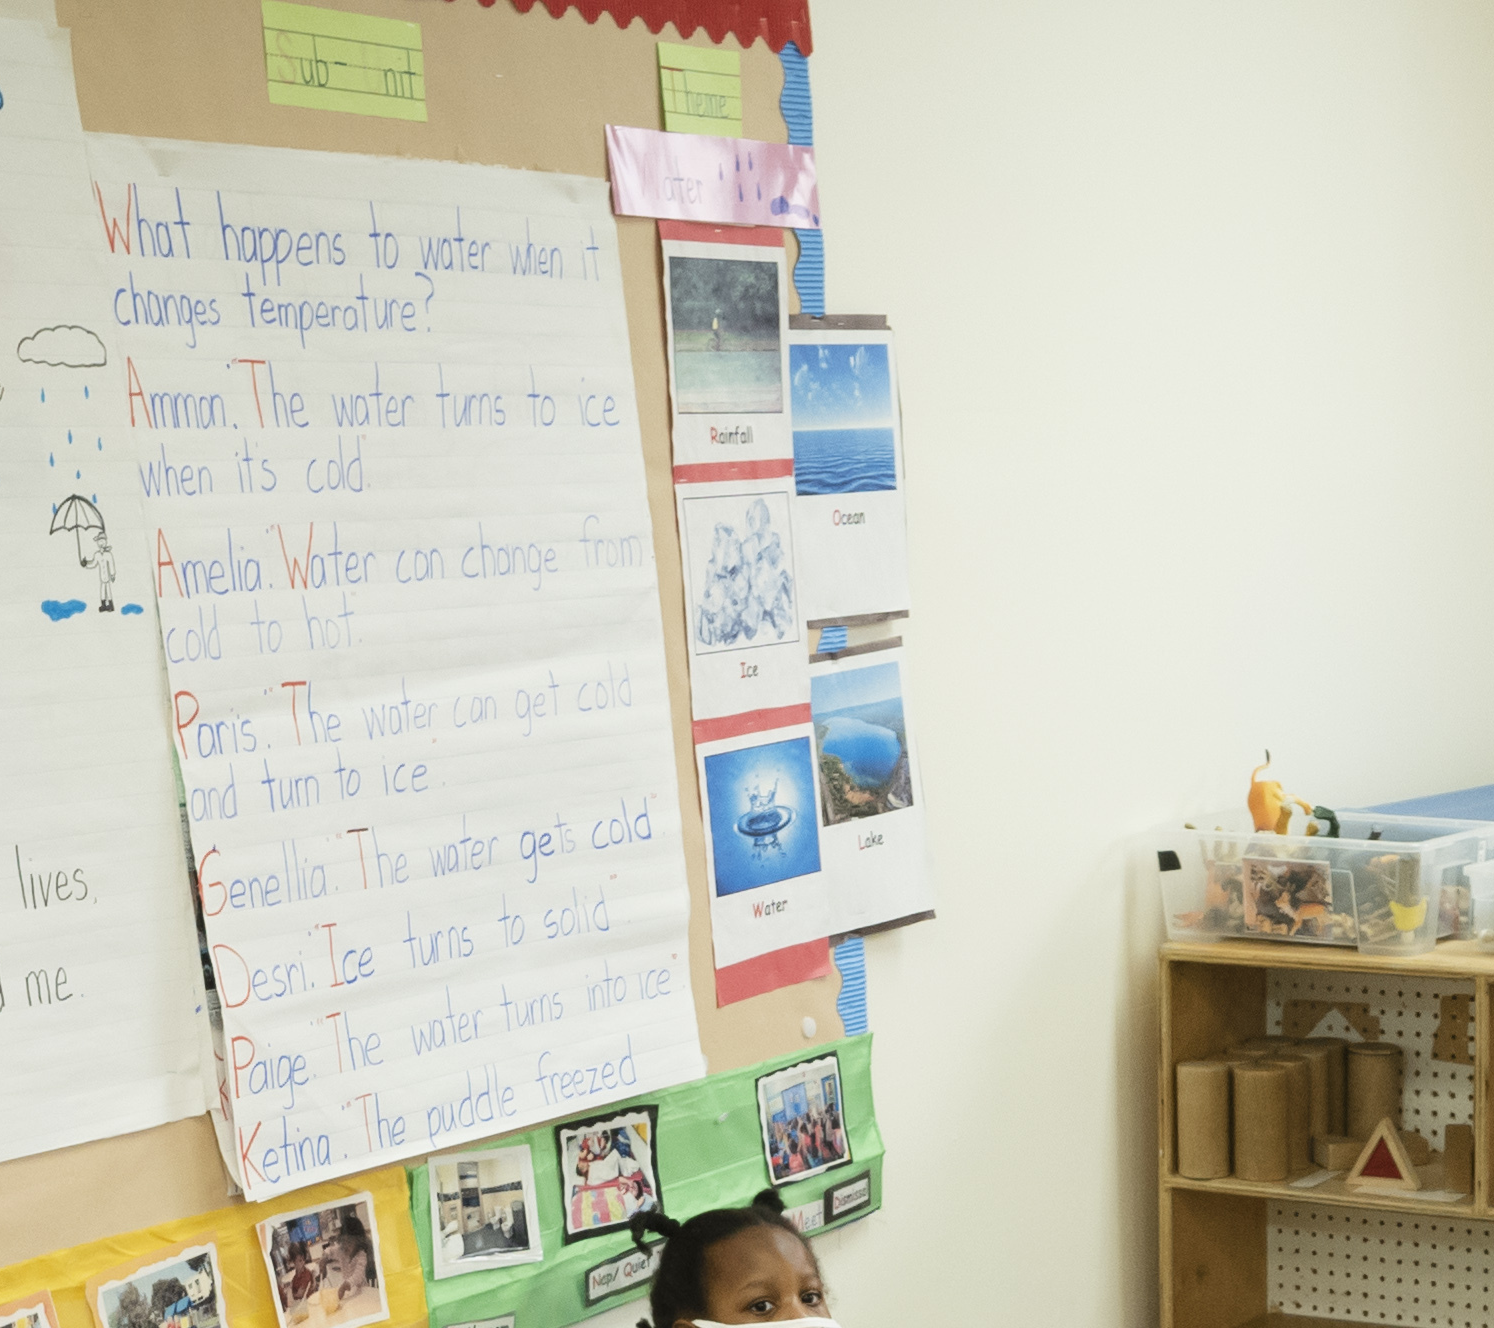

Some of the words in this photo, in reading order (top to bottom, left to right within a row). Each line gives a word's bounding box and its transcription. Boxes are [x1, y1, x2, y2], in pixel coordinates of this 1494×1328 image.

[659, 65, 729, 119] Theme
[95, 181, 190, 260] What
[217, 190, 346, 286] happens
[368, 201, 399, 269] to
[421, 206, 492, 272] water
[509, 219, 562, 279] when
[581, 226, 600, 281] it
[114, 272, 221, 348] changes
[243, 272, 435, 347] temperature?
[332, 362, 415, 427] water
[436, 364, 506, 426] turns
[527, 365, 555, 426] to
[579, 378, 621, 427] ice
[711, 426, 753, 446] Rainfall
[140, 443, 213, 498] when
[832, 509, 866, 526] Ocean
[396, 545, 444, 583] can
[461, 522, 559, 592] change
[578, 514, 643, 568] from
[166, 600, 222, 664] cold
[250, 599, 282, 654] to
[362, 677, 437, 735] water
[453, 692, 498, 729] can
[515, 670, 560, 737] get
[577, 660, 632, 713] cold
[740, 660, 759, 679] Ice
[191, 763, 238, 823] and
[261, 758, 320, 813] turn
[334, 747, 361, 799] to
[430, 812, 499, 878] water
[520, 811, 577, 884] gets
[858, 831, 885, 850] Lake
[403, 910, 474, 969] turns
[498, 893, 525, 947] to
[752, 898, 788, 918] Water
[410, 984, 483, 1056] water
[500, 984, 565, 1034] turns
[585, 960, 628, 1012] into
[426, 1063, 518, 1149] puddle
[535, 1034, 638, 1106] freezed
[791, 1208, 823, 1232] Meet
[593, 1265, 619, 1290] Nap/
